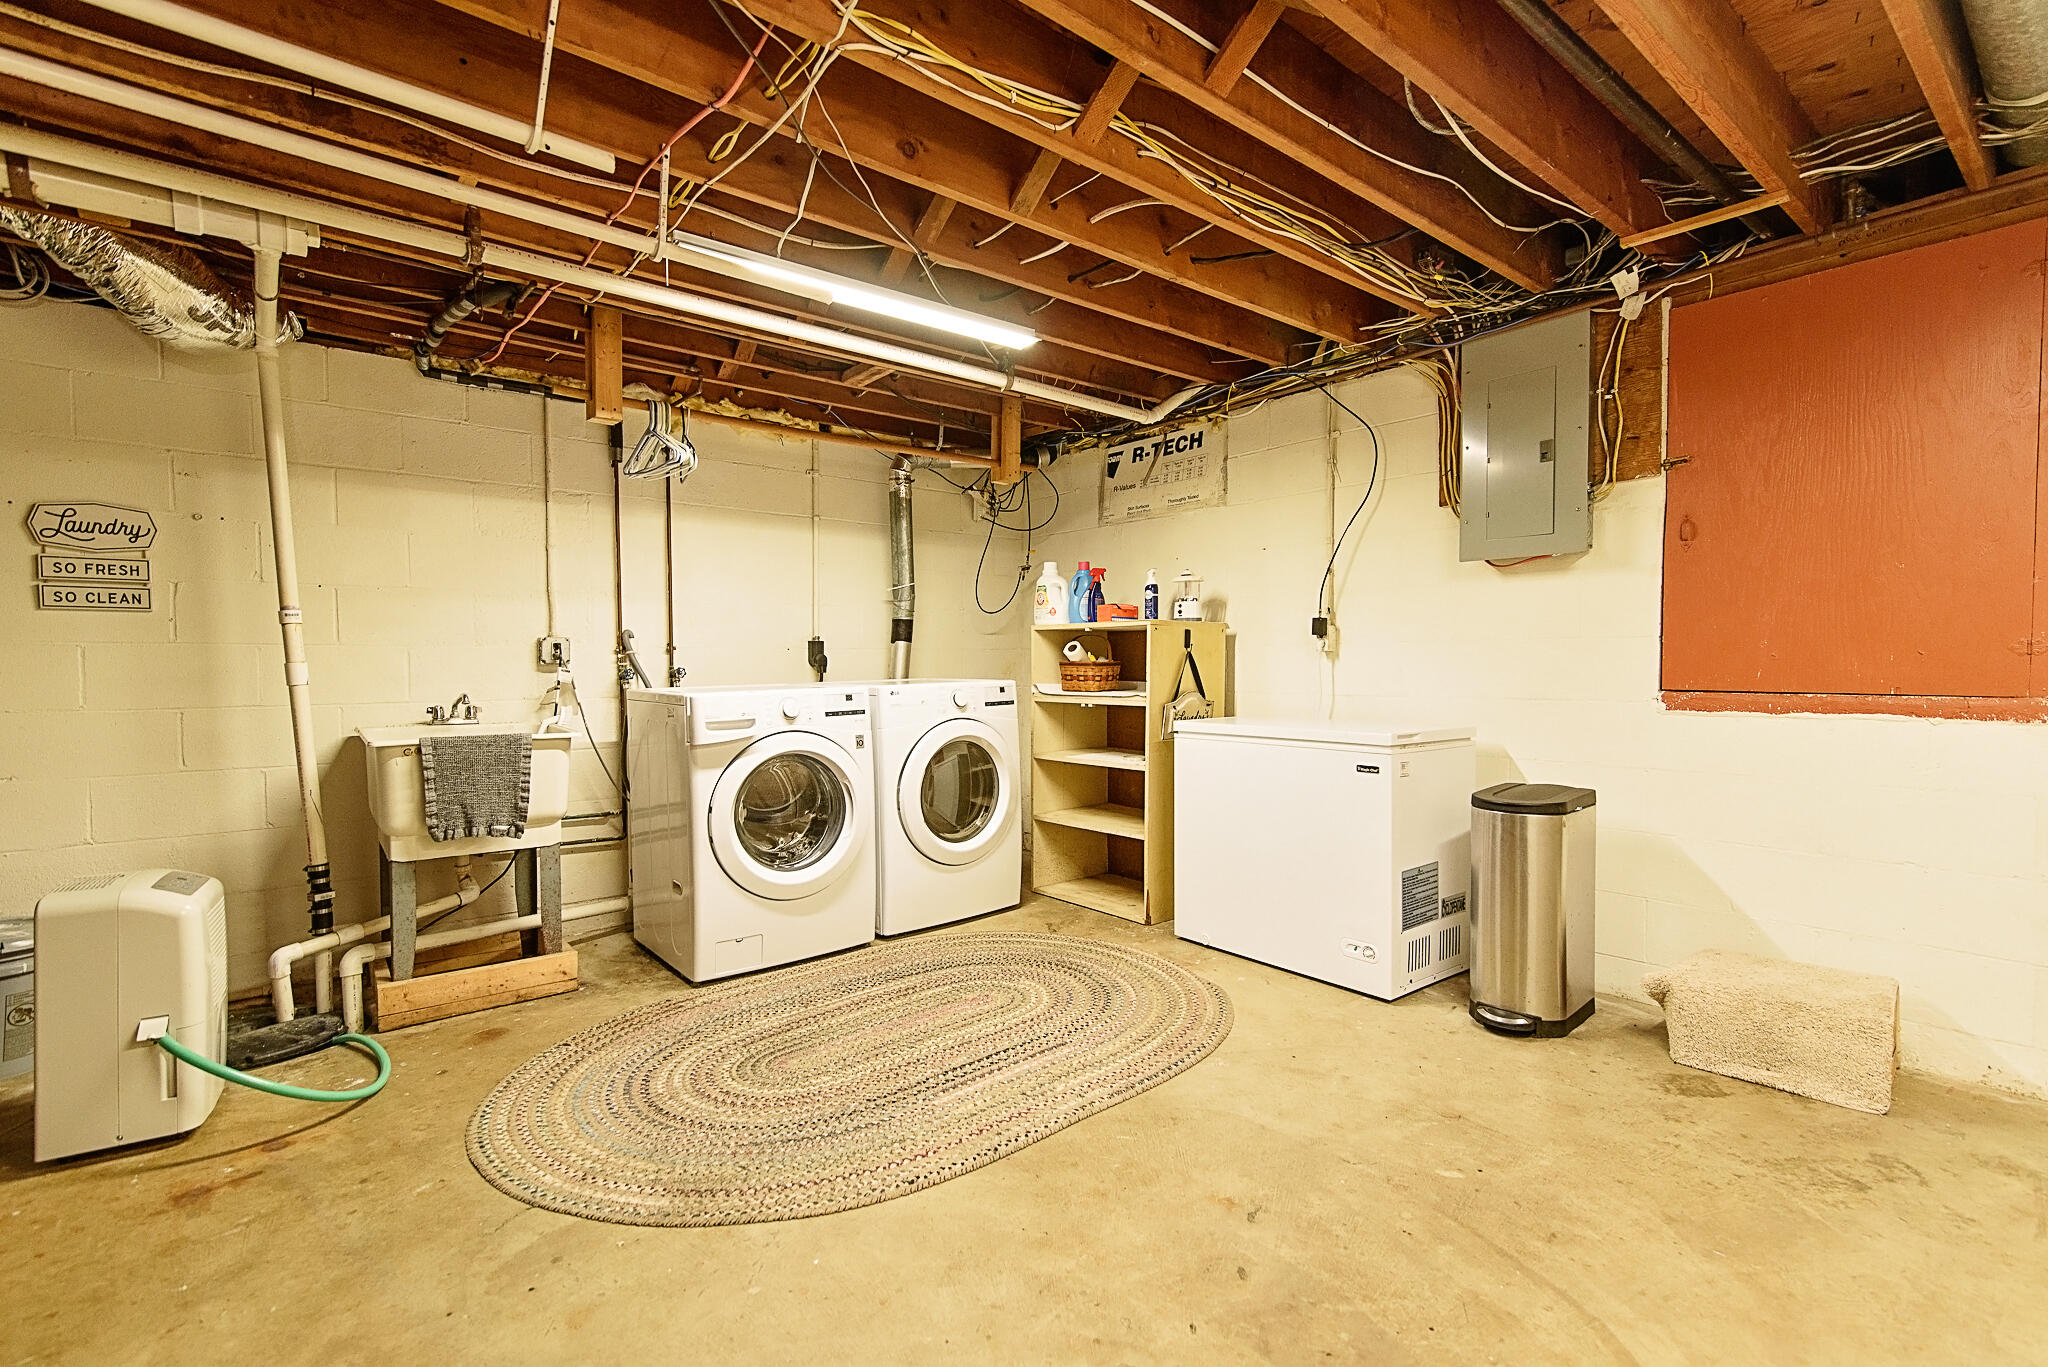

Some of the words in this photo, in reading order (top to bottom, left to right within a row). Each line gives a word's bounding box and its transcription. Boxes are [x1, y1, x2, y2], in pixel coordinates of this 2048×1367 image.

[1131, 431, 1204, 463] R-TECH
[40, 508, 150, 543] Laundry
[53, 562, 76, 574] SO
[85, 563, 140, 576] FRESH
[53, 591, 77, 603] SO
[85, 592, 142, 604] CLEAN
